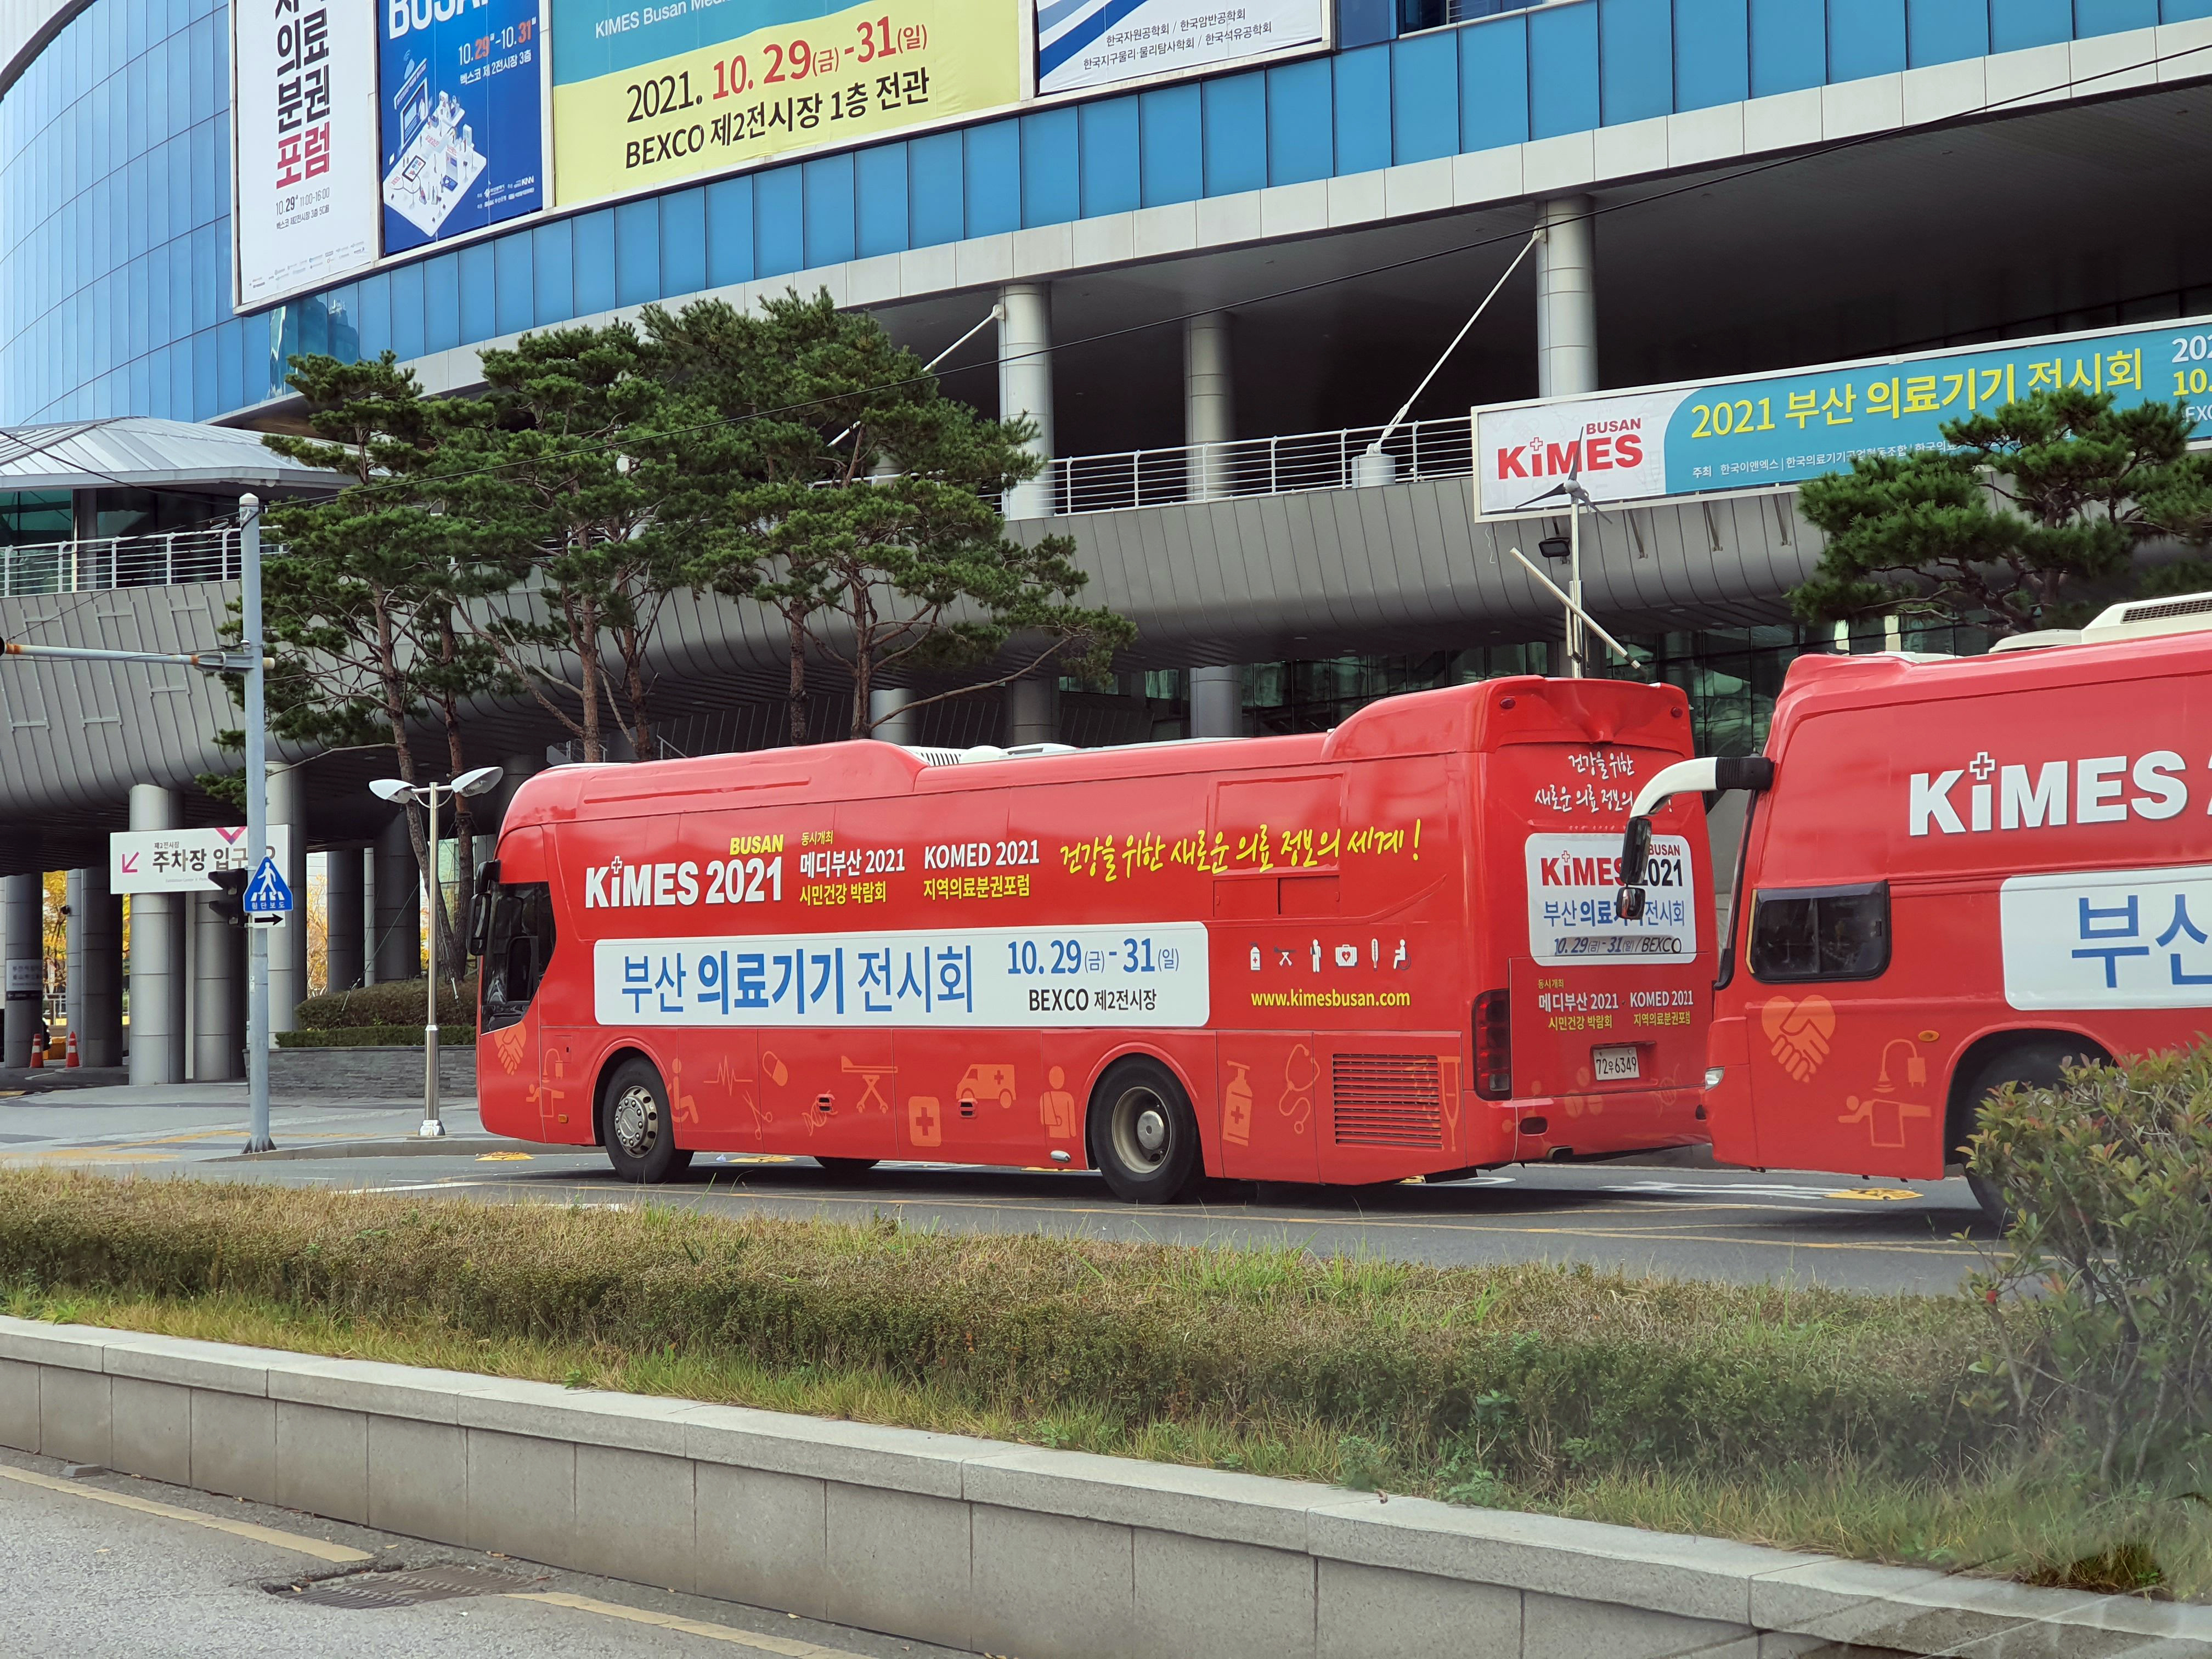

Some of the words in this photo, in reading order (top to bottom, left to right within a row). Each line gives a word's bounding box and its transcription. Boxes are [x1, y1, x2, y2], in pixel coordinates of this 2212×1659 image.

[595, 11, 639, 38] KIMES
[644, 1, 686, 25] Busan
[1107, 24, 1170, 47] 한국자원공학회
[1180, 8, 1246, 32] 한국암반공학회
[1205, 21, 1272, 46] 한국석유공학회
[277, 7, 329, 77] 의료
[460, 67, 482, 85] 벡스코
[519, 49, 532, 65] 3층
[627, 71, 703, 123] 2021.
[712, 54, 754, 100] 10.
[763, 38, 839, 85] 29(금)
[279, 63, 329, 134] 분권
[625, 124, 705, 170] BEXCO
[710, 95, 823, 147] 제2전시장
[830, 82, 868, 122] 1층
[876, 67, 930, 110] 전관
[276, 121, 329, 190] 포럼
[1690, 397, 1776, 439] 2021
[1785, 383, 1857, 430] 부산
[1866, 364, 2015, 419] 의료기기
[2027, 347, 2142, 395] 전시회
[1586, 417, 1641, 436] BUSAN
[1692, 465, 1712, 479] 주최
[1720, 458, 1779, 476] 한국이앤엑스
[1568, 751, 1609, 780] 건강을
[1609, 751, 1635, 779] 위한
[1534, 783, 1572, 812] 새로운
[1576, 784, 1599, 814] 의료
[730, 833, 784, 855] BUSAN
[800, 829, 834, 846] 동시개최
[1649, 844, 1681, 856] BUSAN
[153, 848, 207, 873] 주차장
[213, 847, 249, 871] 입구
[800, 849, 862, 878] 메디부산
[865, 848, 906, 874] 2021
[924, 843, 991, 870] KOMED
[995, 839, 1040, 866] 2021
[1060, 833, 1118, 882] 건강을
[1122, 831, 1166, 878] 위한
[1170, 829, 1230, 874] 새로운
[1236, 823, 1274, 873] 의료
[1280, 828, 1341, 868] 정보의
[1346, 826, 1404, 855] 세계
[705, 856, 782, 904] 2021
[923, 873, 1030, 900] 지역의료분권포럼
[1643, 858, 1683, 887] 021
[799, 882, 848, 906] 시민건강
[850, 881, 887, 904] 박람회
[1543, 900, 1577, 927] 부산
[1580, 899, 1643, 927] 의료
[1645, 900, 1685, 926] 전시회
[1007, 941, 1045, 974] 10.
[622, 951, 686, 1014] 부산
[698, 947, 843, 1015] 의료기기
[857, 945, 973, 1014] 전시회
[1538, 979, 1564, 989] 동시개최
[1029, 989, 1089, 1012] BEXCO
[1094, 989, 1157, 1012] 제2전시장
[1251, 988, 1410, 1009] www.kimesbusan.com
[1538, 991, 1587, 1013] 메디부산
[1590, 992, 1619, 1010] 2021
[1629, 991, 1669, 1008] KOMED
[1672, 990, 1694, 1006] 2021
[1548, 1015, 1585, 1031] 시민건강
[1587, 1014, 1612, 1029] 박람회
[1634, 1010, 1691, 1028] 지역의료분권포럼
[1595, 1056, 1638, 1075] 72우6349
